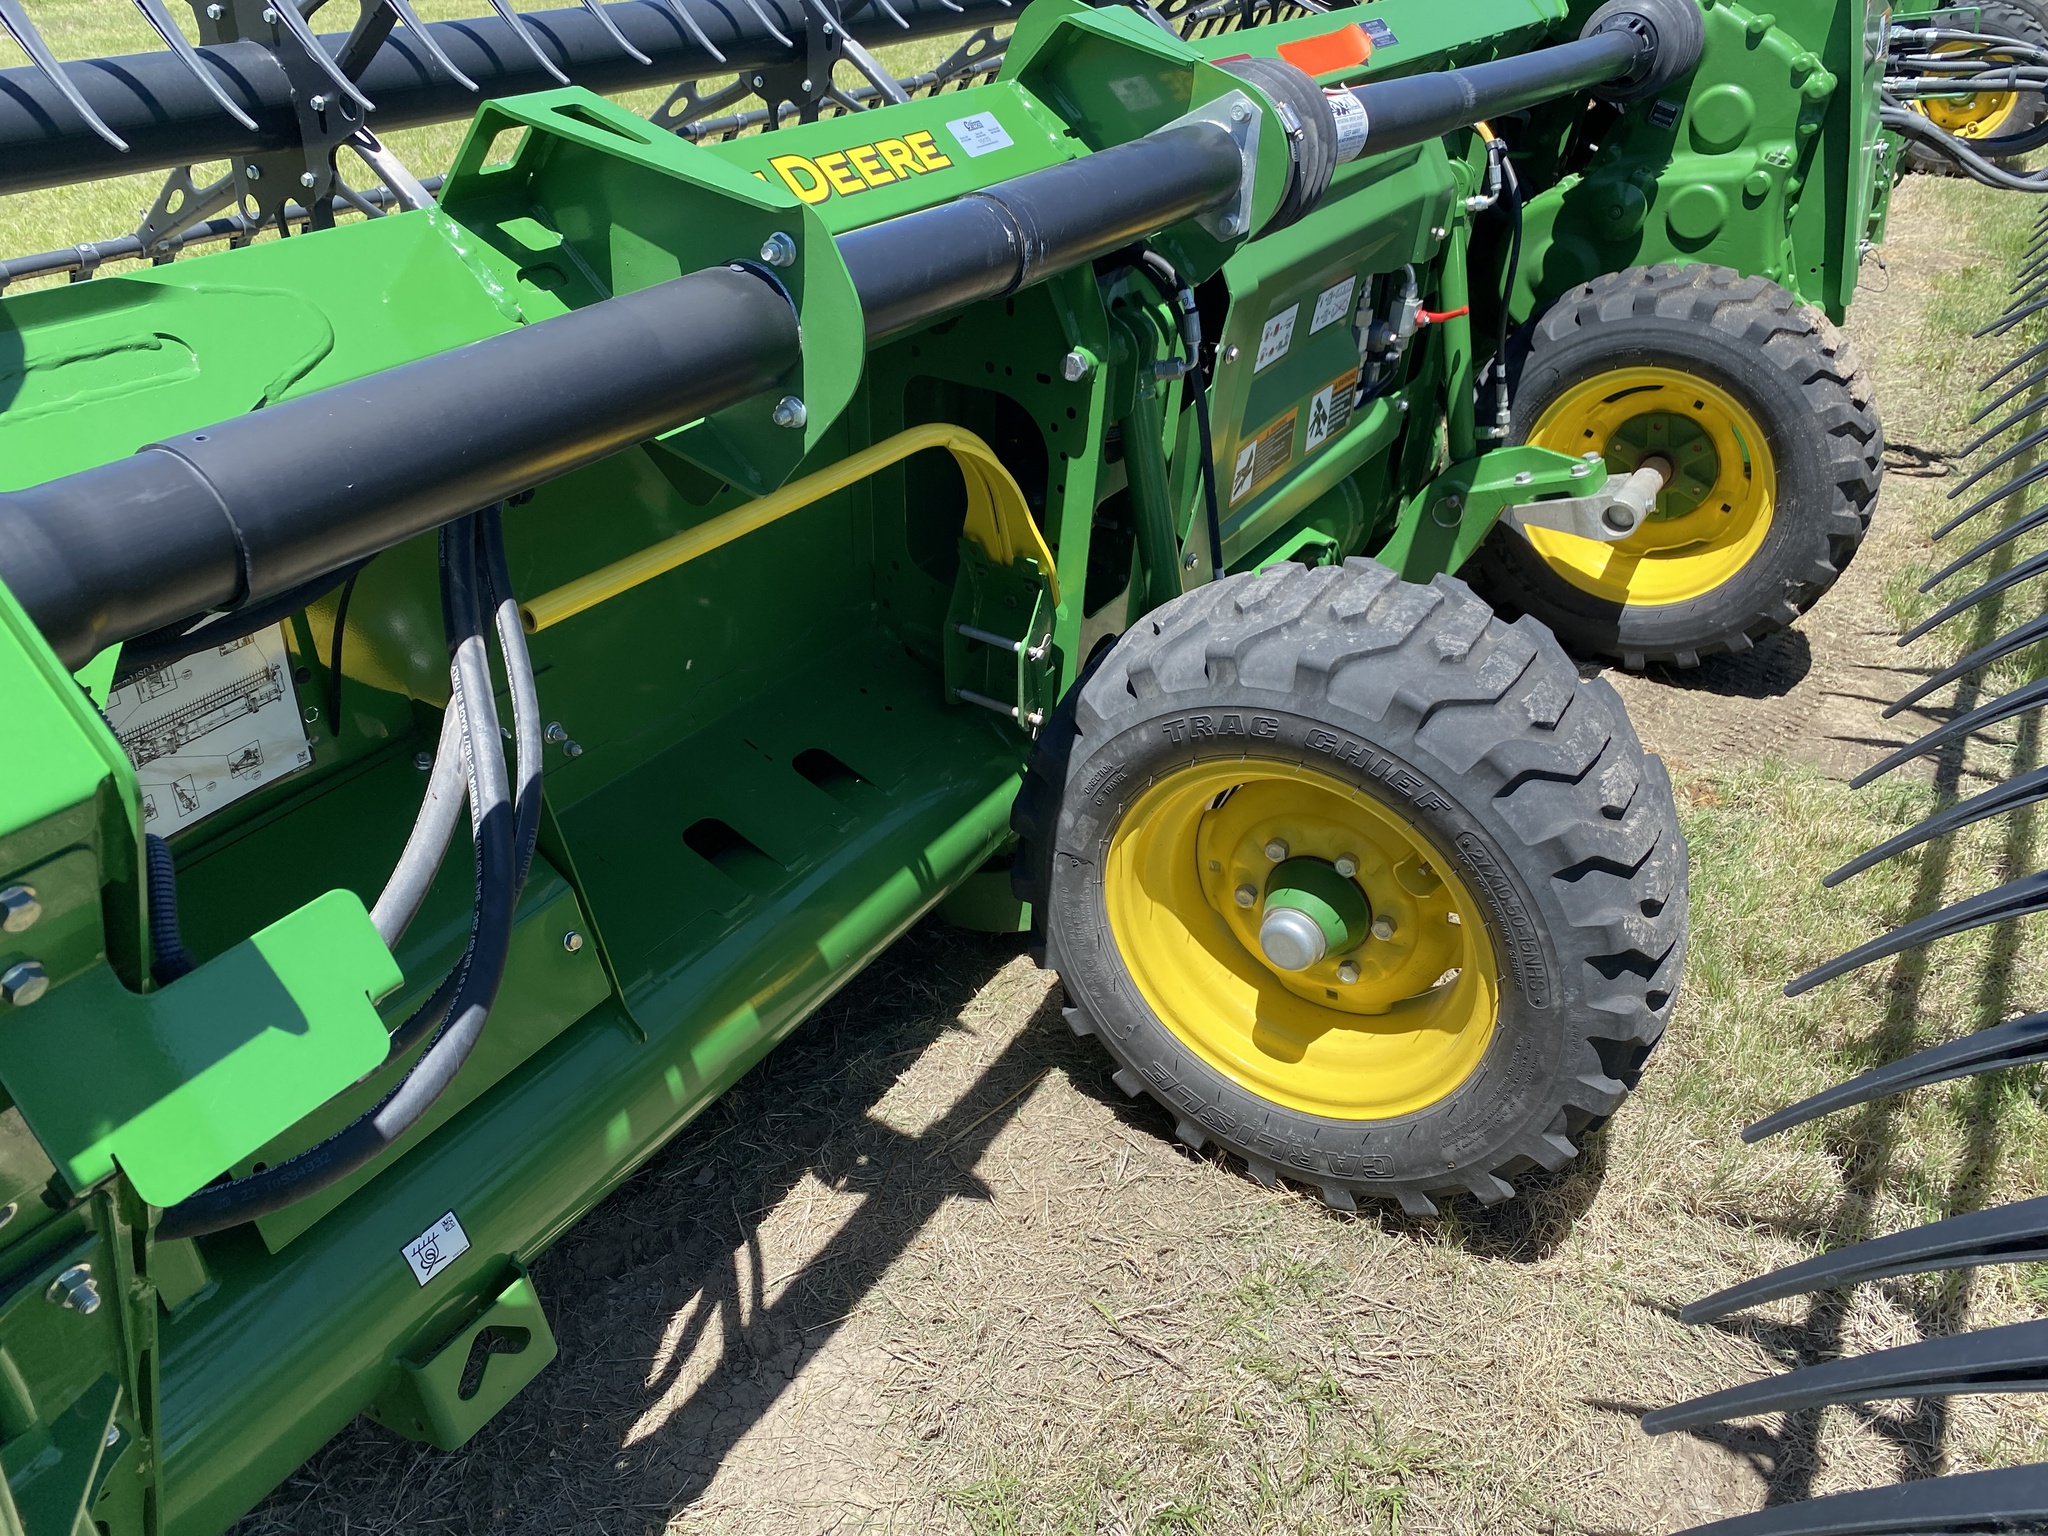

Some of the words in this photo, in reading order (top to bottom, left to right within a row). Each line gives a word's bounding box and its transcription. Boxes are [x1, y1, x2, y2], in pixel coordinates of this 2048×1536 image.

[768, 130, 955, 205] DEERE
[452, 664, 463, 690] ITALY
[456, 690, 464, 701] IN
[459, 702, 469, 733] MADE
[1084, 762, 1114, 794] DIRECTION
[1162, 714, 1280, 742] TRAC
[1305, 728, 1452, 812] CHIEF
[1095, 794, 1105, 806] OF
[1105, 772, 1128, 796] TRAVEL
[1072, 907, 1088, 951] TUBELESS
[1468, 848, 1545, 992] 27X10.50-15NHS
[1488, 899, 1514, 946] HIGHWAY
[1508, 950, 1524, 992] SERVICE
[1141, 1061, 1396, 1178] CARLISLE
